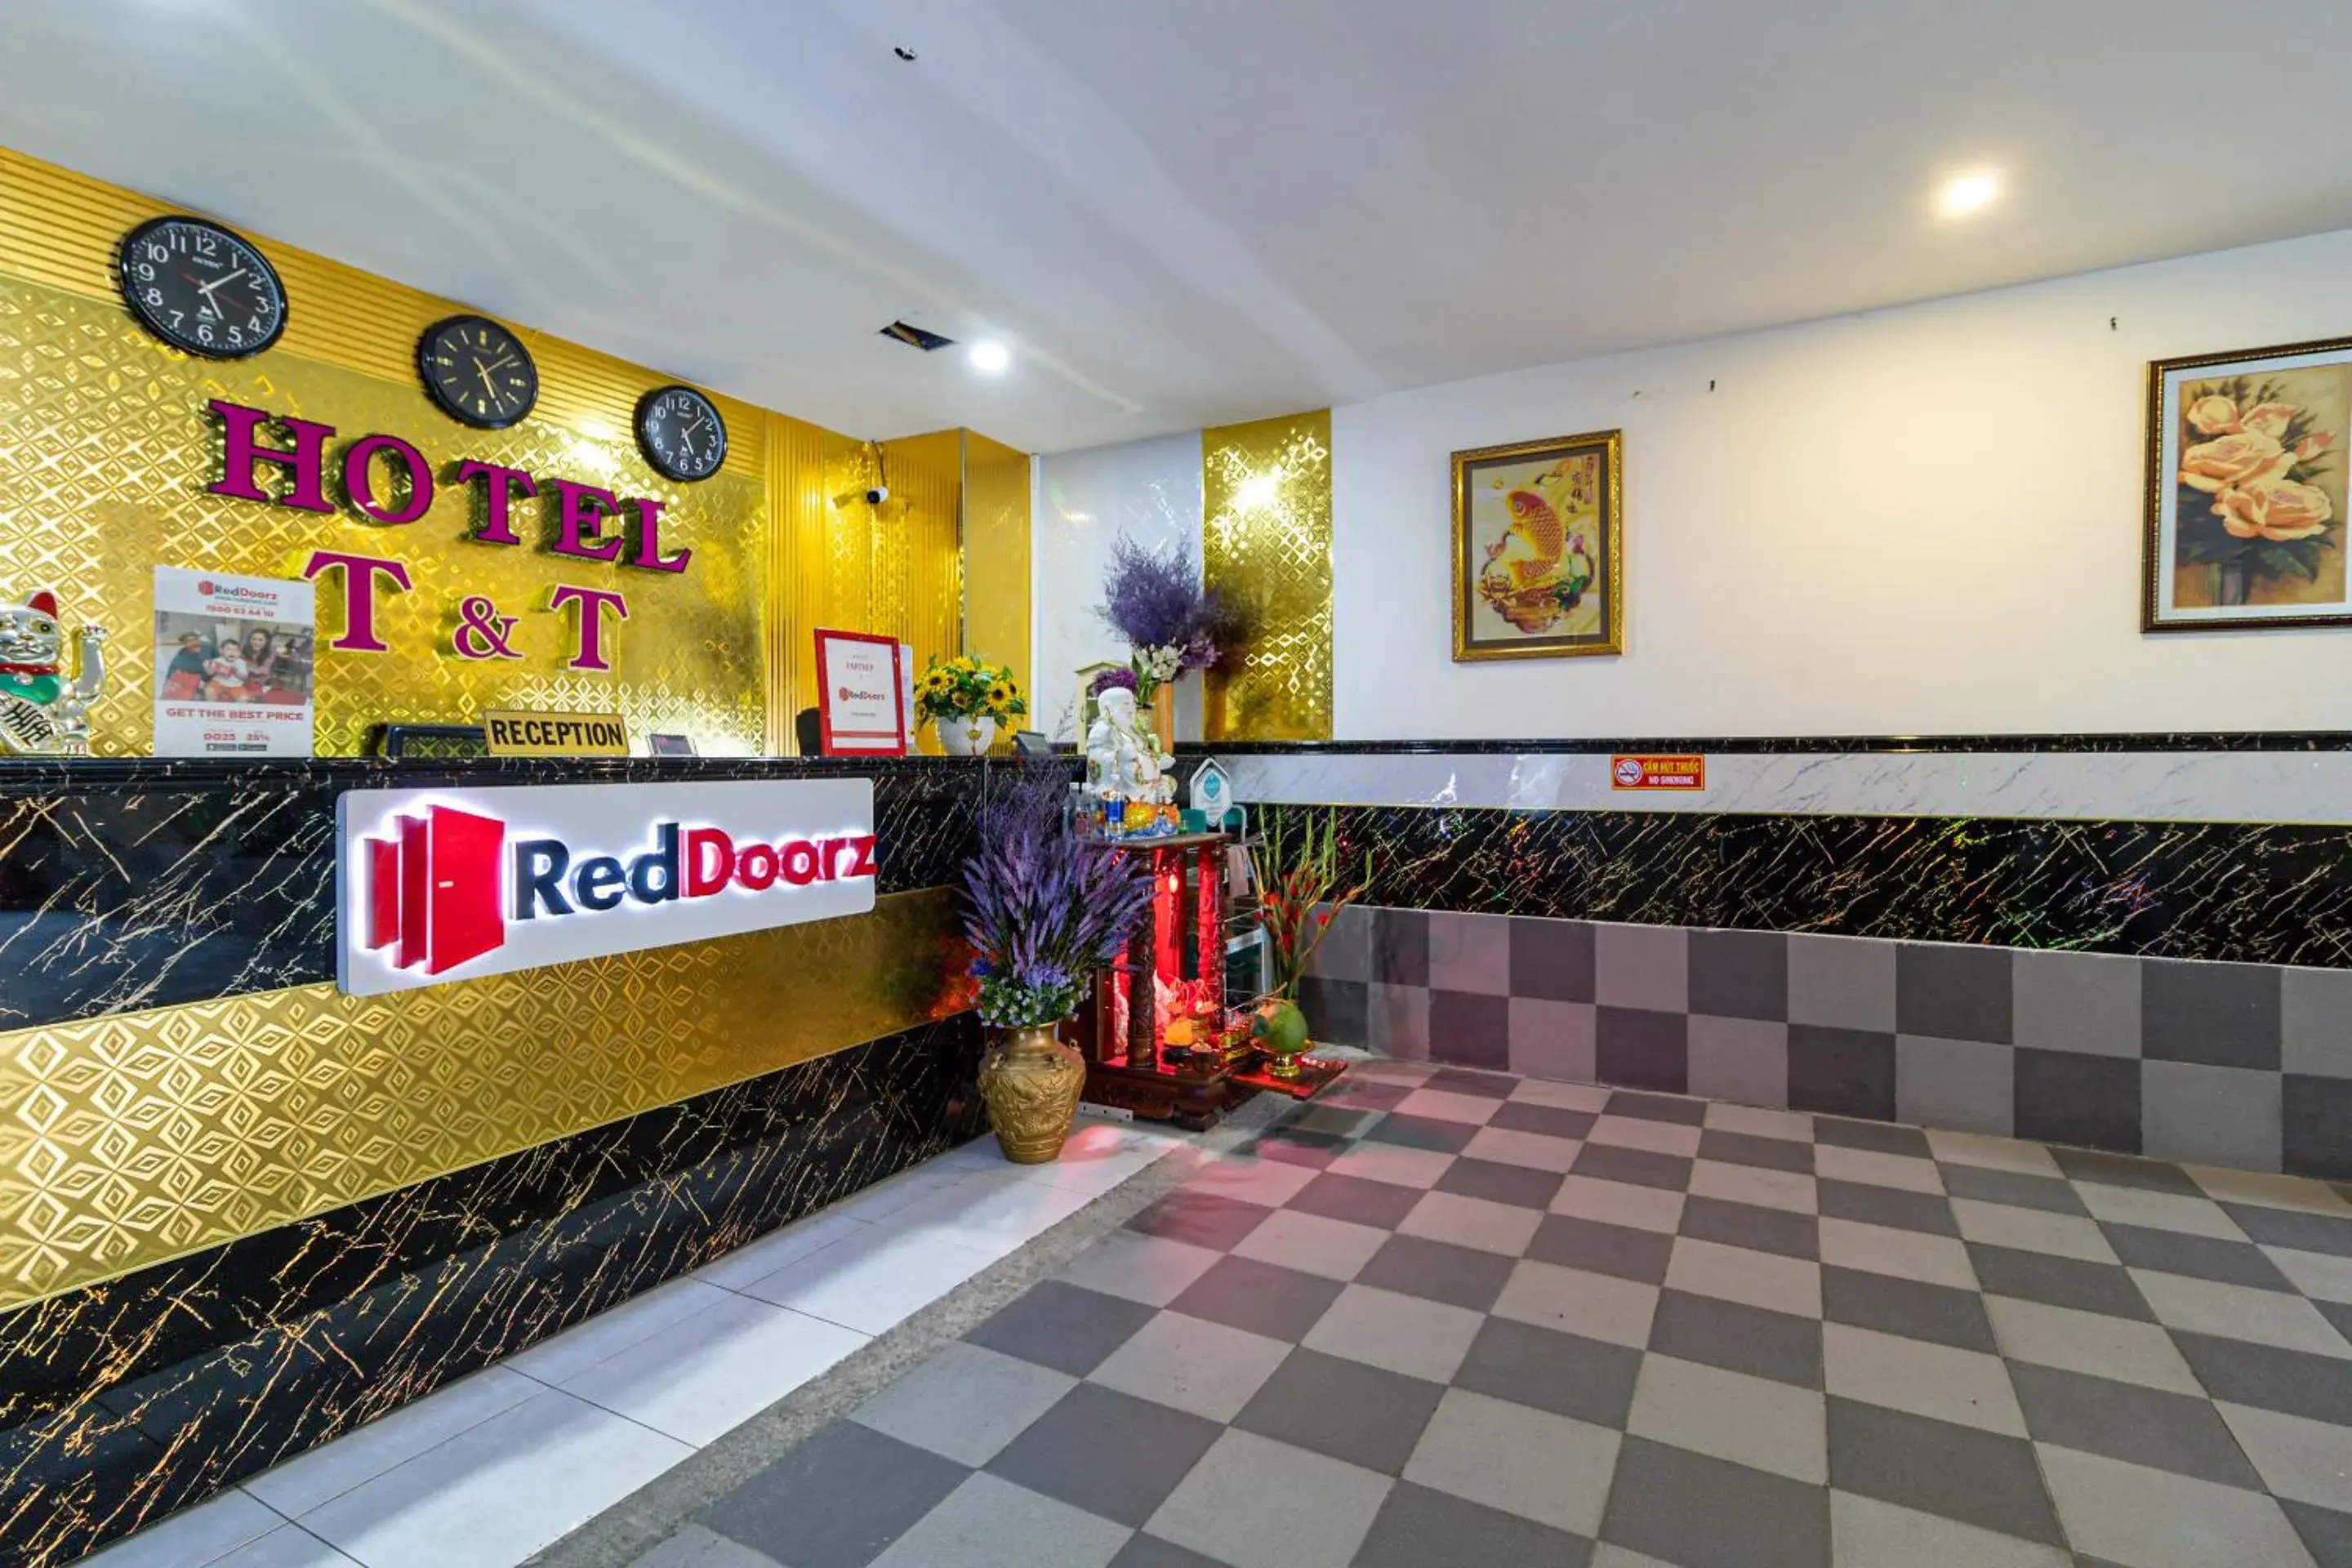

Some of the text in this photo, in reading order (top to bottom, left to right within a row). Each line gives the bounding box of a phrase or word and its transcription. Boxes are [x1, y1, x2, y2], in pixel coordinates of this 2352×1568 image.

[170, 229, 186, 253] 11
[196, 235, 216, 256] 12
[148, 243, 169, 263] 10
[232, 252, 238, 269] 1
[138, 263, 154, 282] 9
[248, 274, 265, 291] 2
[146, 288, 163, 306] 8
[255, 296, 269, 314] 3
[169, 310, 184, 327] 7
[247, 316, 265, 335] 4
[198, 325, 213, 342] 6
[227, 326, 242, 343] 5
[666, 395, 675, 411] 11
[679, 396, 690, 410] 12
[697, 406, 701, 417] 1
[653, 405, 666, 419] 10
[651, 420, 659, 432] 9
[705, 419, 713, 431] 2
[654, 437, 663, 449] 8
[709, 434, 716, 448] 3
[666, 451, 674, 465] 7
[695, 457, 702, 470] 5
[706, 449, 715, 461] 4
[679, 459, 688, 471] 6
[207, 399, 692, 573] HOTEL
[215, 585, 278, 599] RedDoorz
[304, 550, 630, 672] T & T
[166, 708, 195, 718] GET
[198, 709, 226, 719] THE
[229, 710, 264, 719] BEST
[266, 710, 305, 721] PRICE
[491, 719, 624, 746] RECEPTION
[1648, 775, 1694, 784] NO SMOKING
[510, 822, 877, 920] RedDoorz
